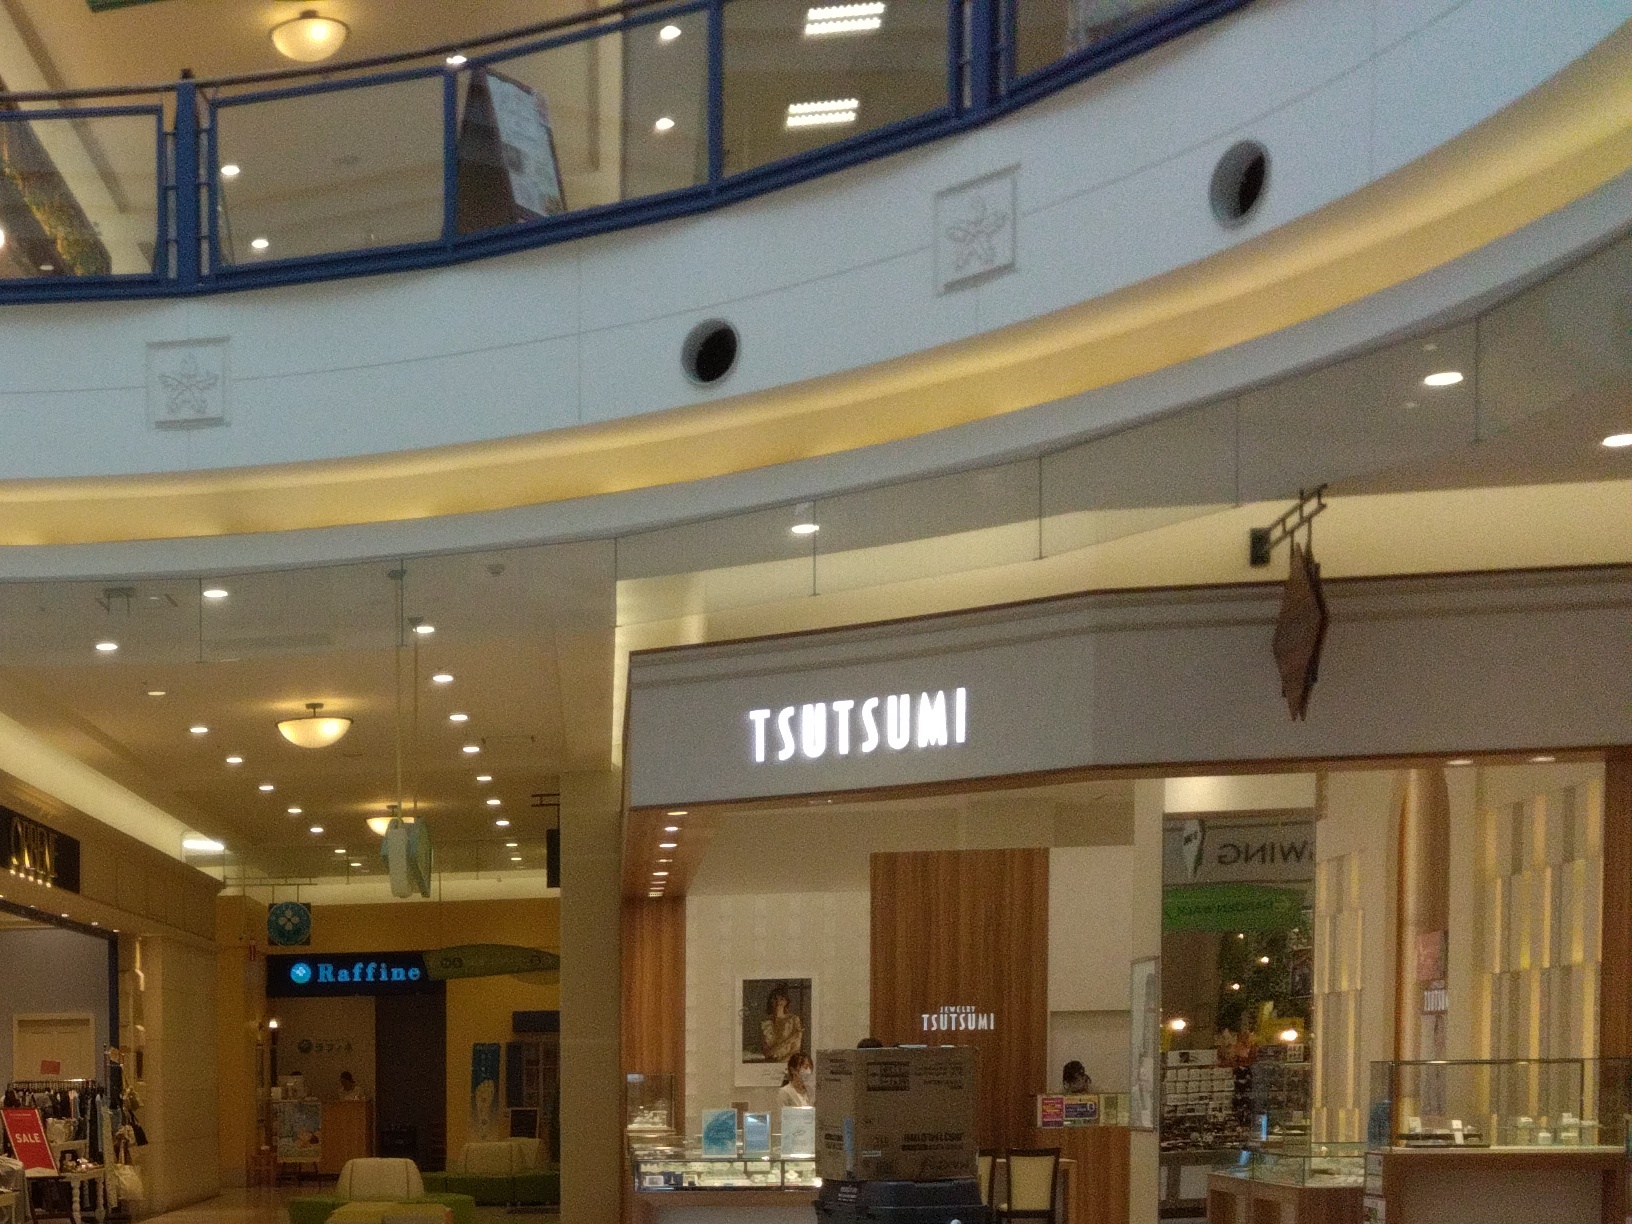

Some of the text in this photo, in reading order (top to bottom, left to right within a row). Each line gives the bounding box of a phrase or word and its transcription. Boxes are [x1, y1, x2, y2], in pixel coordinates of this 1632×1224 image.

[749, 687, 967, 763] TSUTSUMI
[317, 961, 421, 983] Raffine
[940, 1005, 976, 1013] JEWELRY
[921, 1012, 995, 1031] TSUTSUMI
[15, 1133, 41, 1143] SALE
